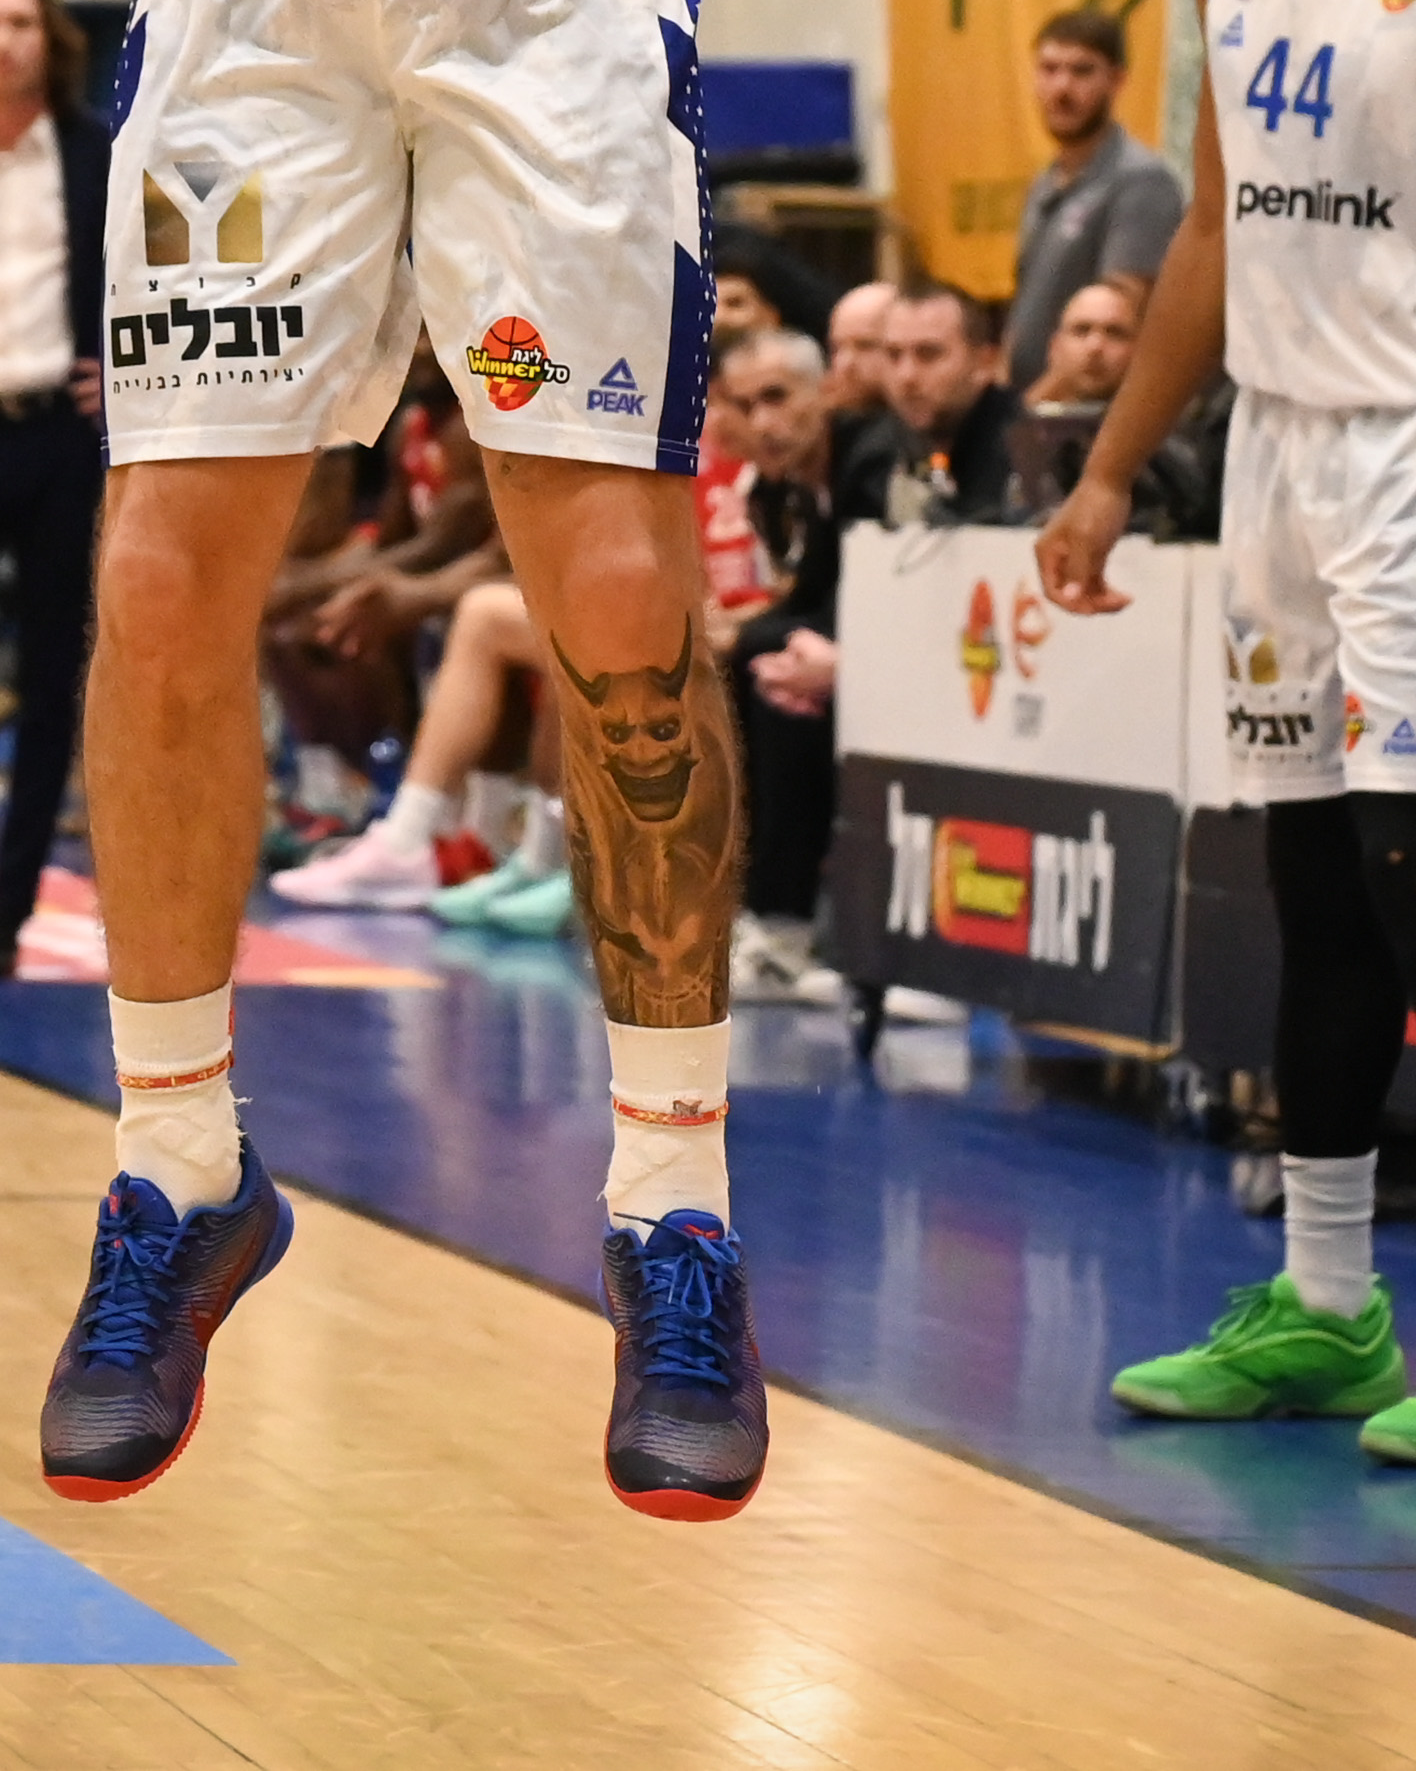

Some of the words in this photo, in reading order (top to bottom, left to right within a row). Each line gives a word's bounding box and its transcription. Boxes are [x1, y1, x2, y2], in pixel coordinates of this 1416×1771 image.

[1245, 36, 1336, 139] 44
[1235, 180, 1398, 230] penlink
[110, 297, 304, 368] יובלים
[466, 347, 541, 379] Winner
[511, 347, 544, 364] ליגת
[543, 361, 569, 381] סל
[586, 388, 648, 417] PEAK
